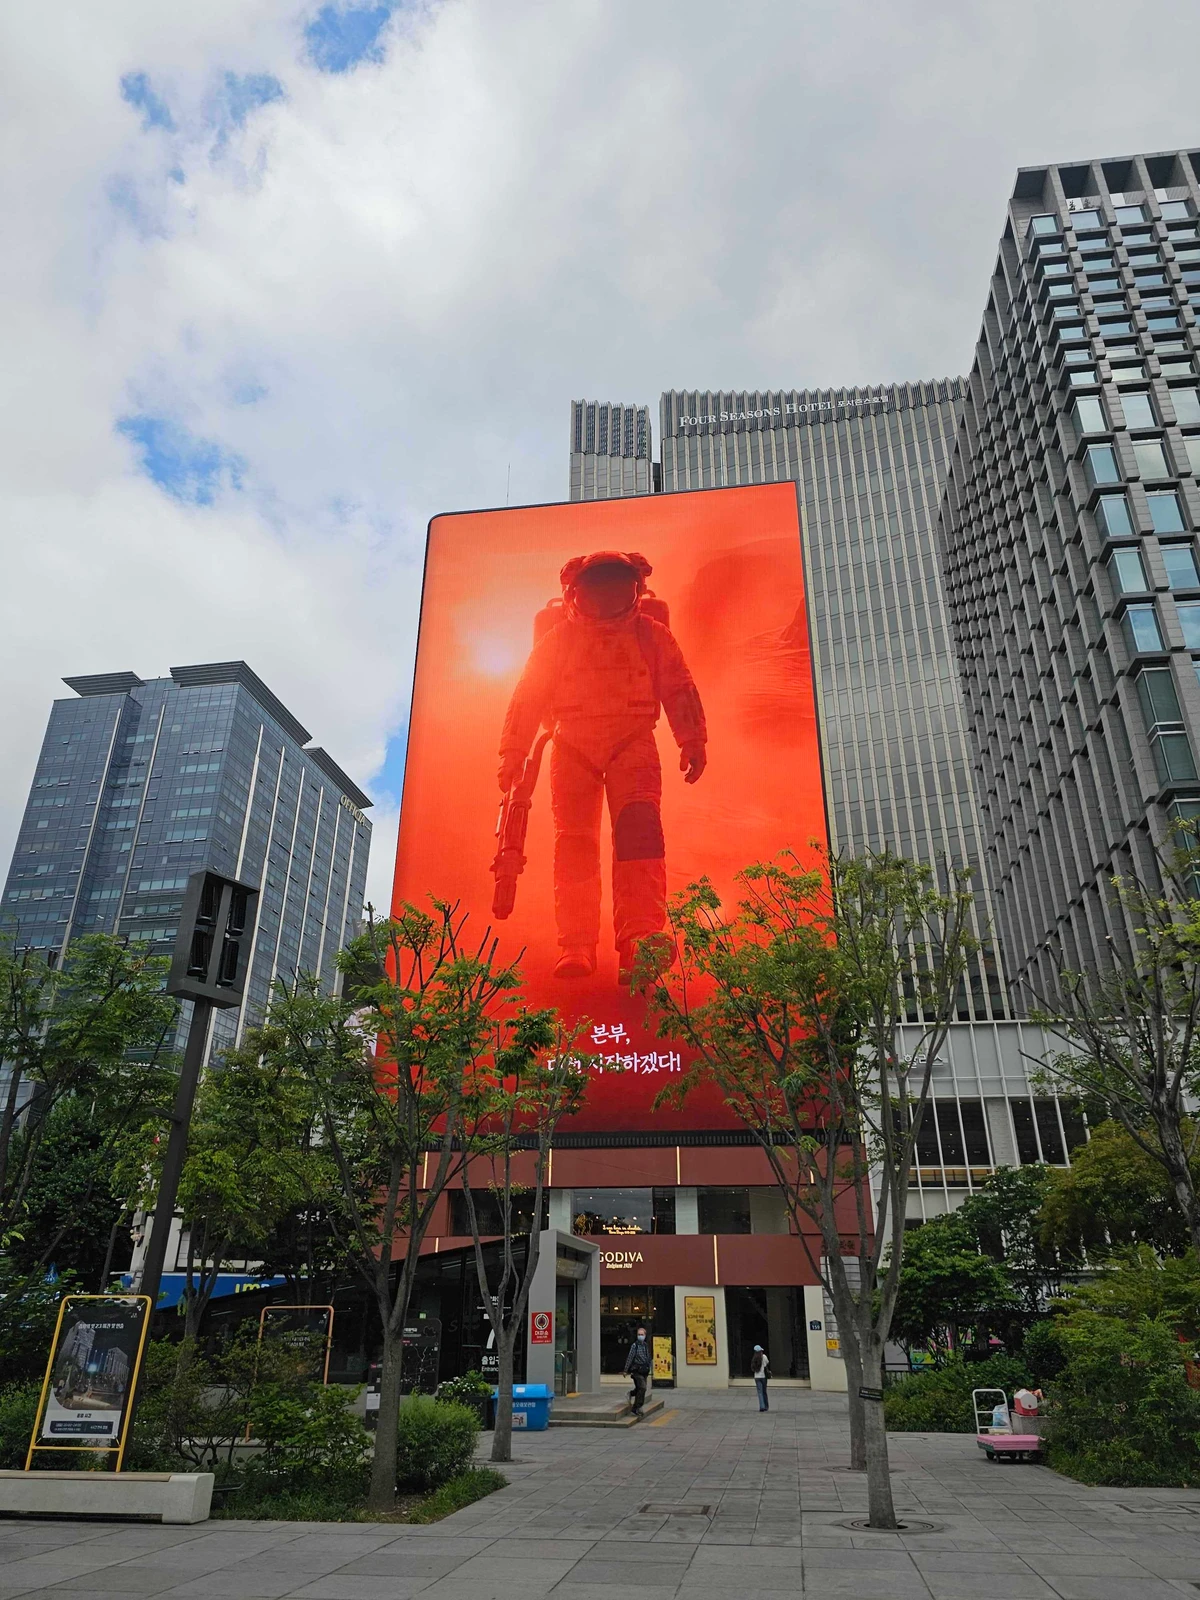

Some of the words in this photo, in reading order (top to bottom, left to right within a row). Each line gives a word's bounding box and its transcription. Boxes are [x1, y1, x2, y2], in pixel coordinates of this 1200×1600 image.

[679, 413, 717, 428] FOUR
[719, 406, 781, 422] SEASONS
[784, 400, 835, 415] HOTEL
[590, 1023, 631, 1045] 본부,
[599, 1252, 643, 1263] GODIVA
